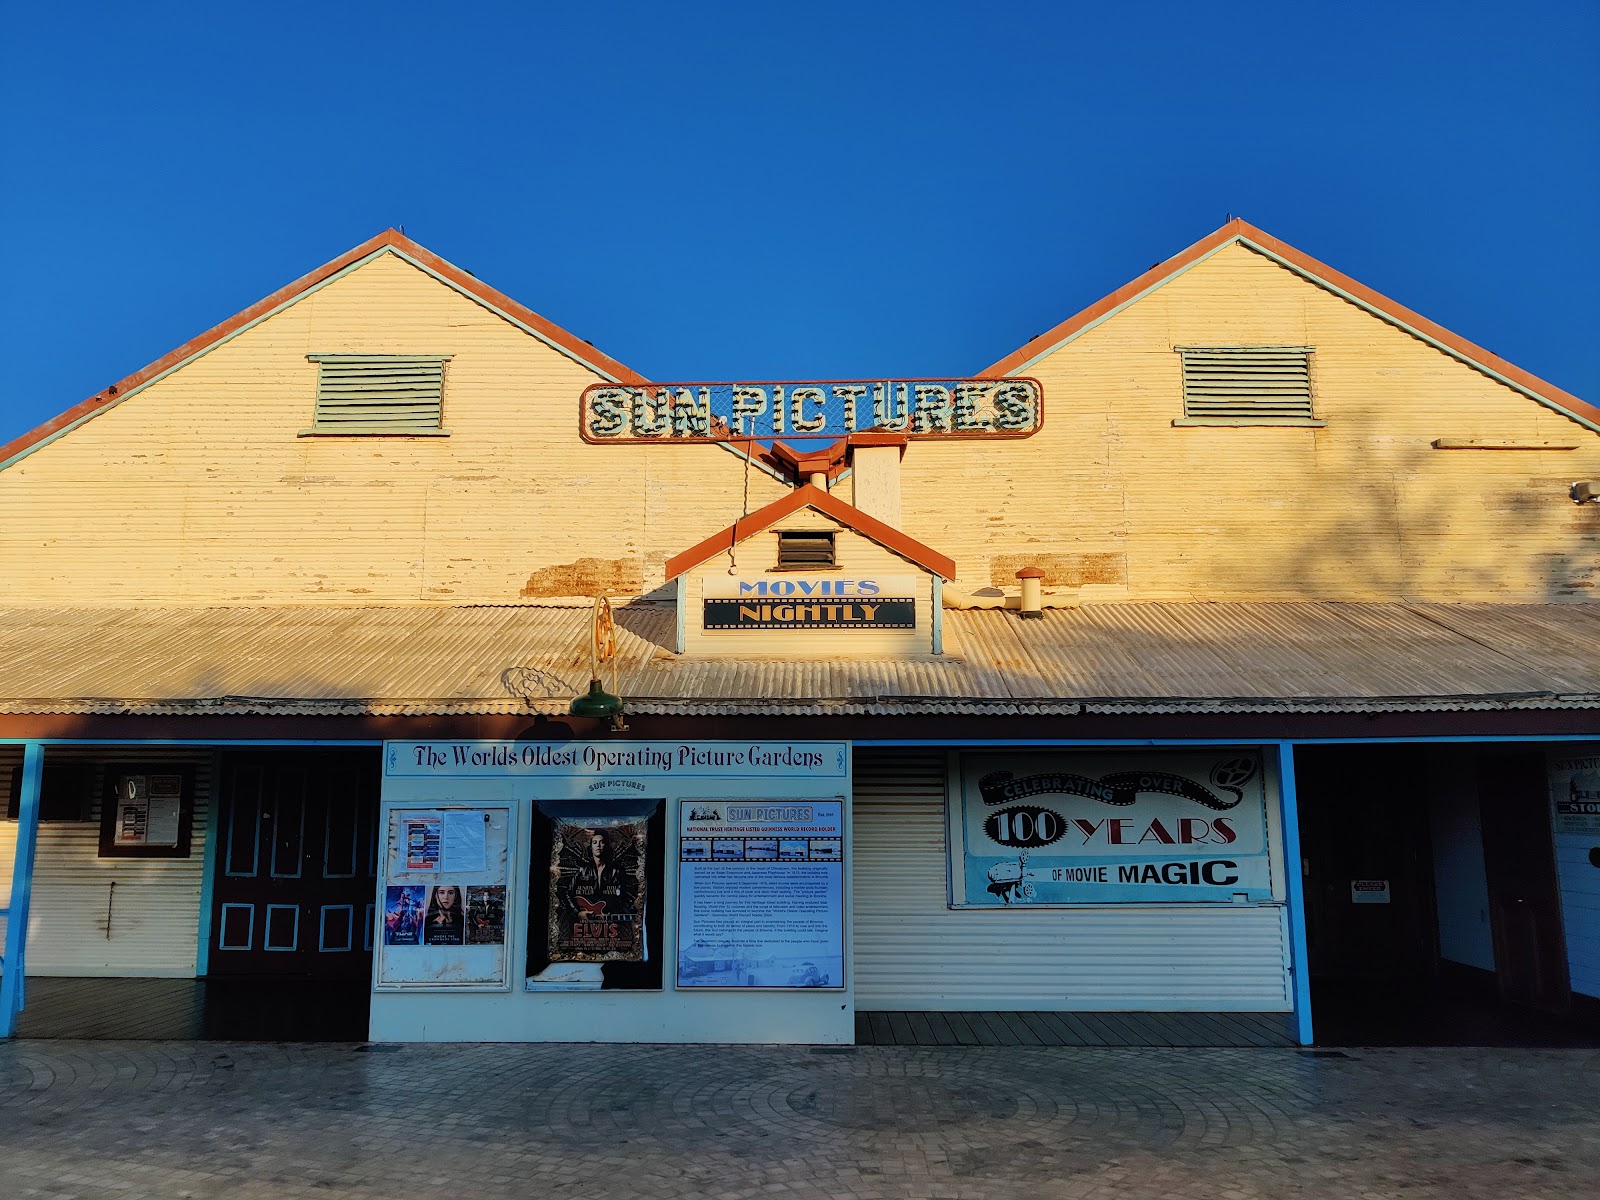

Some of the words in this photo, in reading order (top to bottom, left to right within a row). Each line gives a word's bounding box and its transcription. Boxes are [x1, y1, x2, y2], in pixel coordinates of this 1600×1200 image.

[590, 385, 712, 438] SUN
[731, 379, 1038, 436] PICTURES
[738, 579, 881, 597] MOVIES
[738, 603, 882, 623] NIGHTLY
[412, 745, 448, 767] The
[451, 745, 519, 767] Worlds
[521, 745, 580, 767] Oldest
[582, 745, 674, 770] Operating
[677, 745, 745, 767] Picture
[747, 745, 824, 769] Gardens
[588, 780, 606, 792] SUN
[607, 779, 647, 792] PICTURES
[1003, 776, 1114, 802] CELEBRATING
[1138, 775, 1184, 793] OVER
[728, 807, 752, 821] SUN
[756, 807, 811, 821] PICTURES
[993, 811, 1057, 842] 100
[1069, 816, 1238, 846] YEARS
[1051, 868, 1063, 882] OF
[1065, 866, 1109, 883] MOVIE
[1118, 859, 1239, 886] MAGIC
[573, 922, 620, 938] ELVIS
